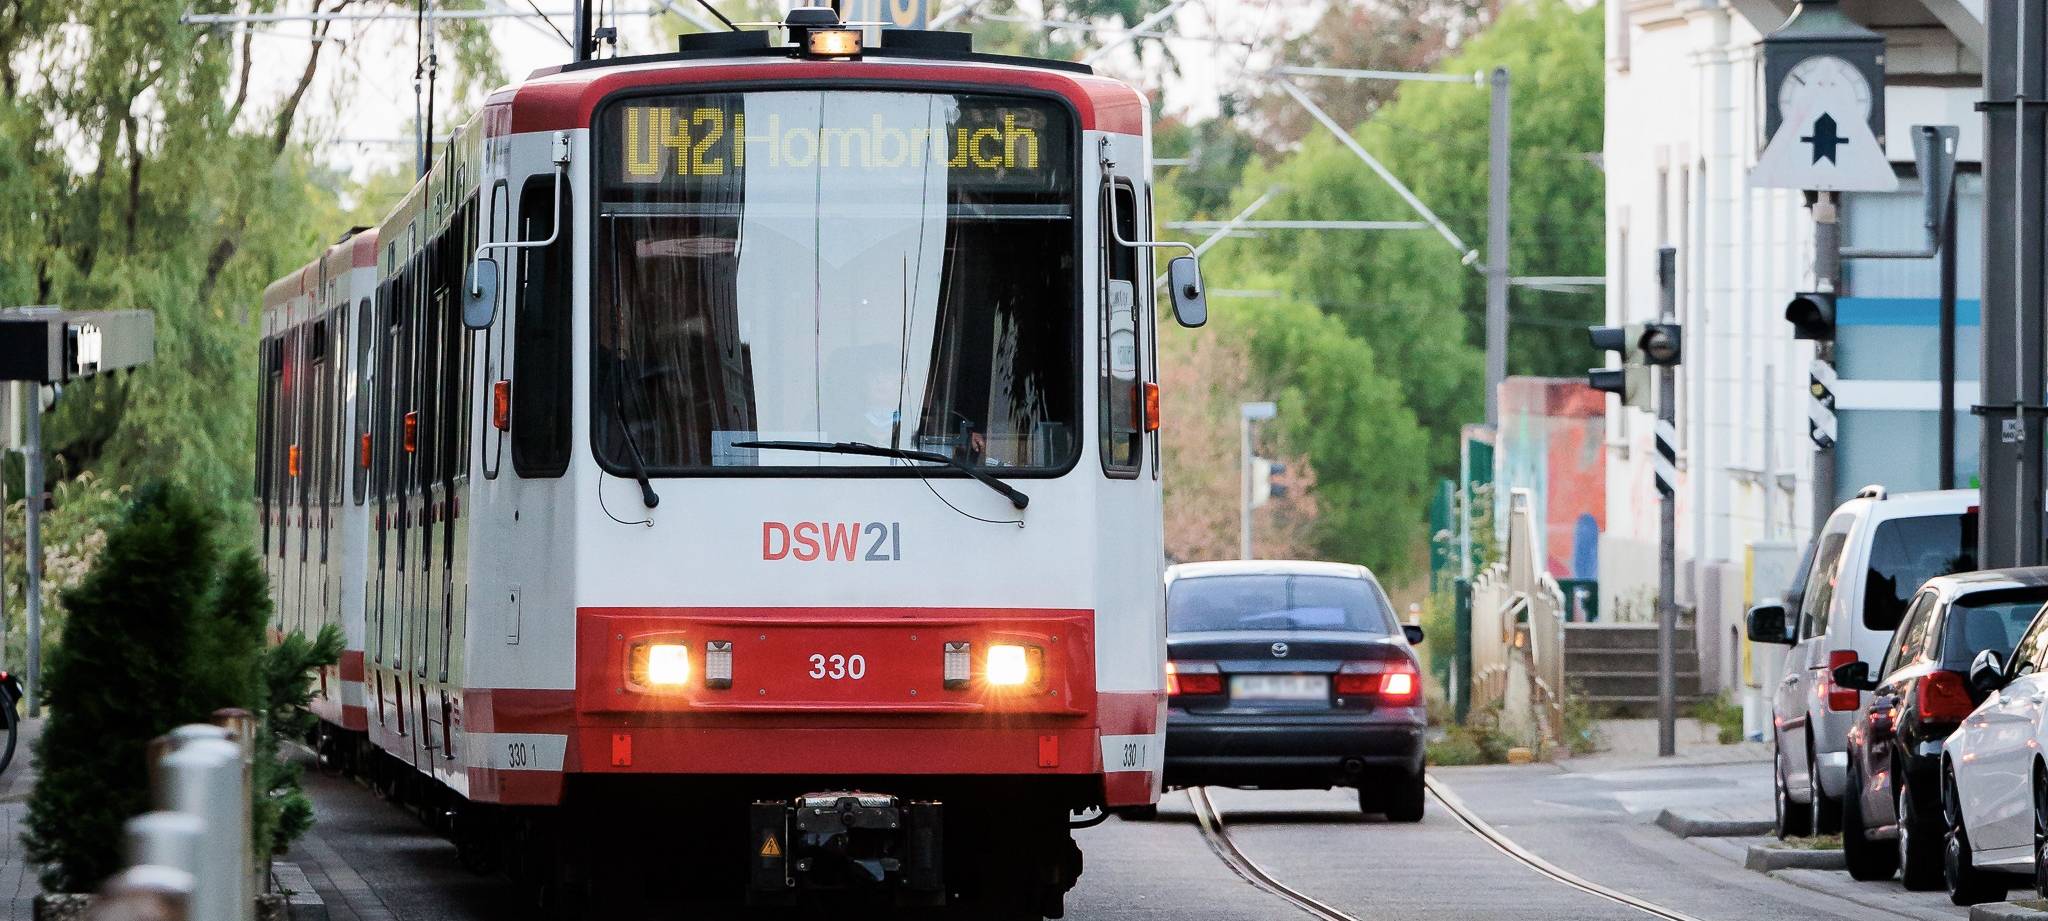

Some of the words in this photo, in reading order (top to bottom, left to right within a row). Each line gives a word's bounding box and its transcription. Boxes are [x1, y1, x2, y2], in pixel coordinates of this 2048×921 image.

[628, 107, 724, 175] U42
[734, 112, 1039, 168] Hombruch
[808, 653, 867, 680] 330
[508, 742, 527, 768] 330
[1122, 743, 1137, 767] 330
